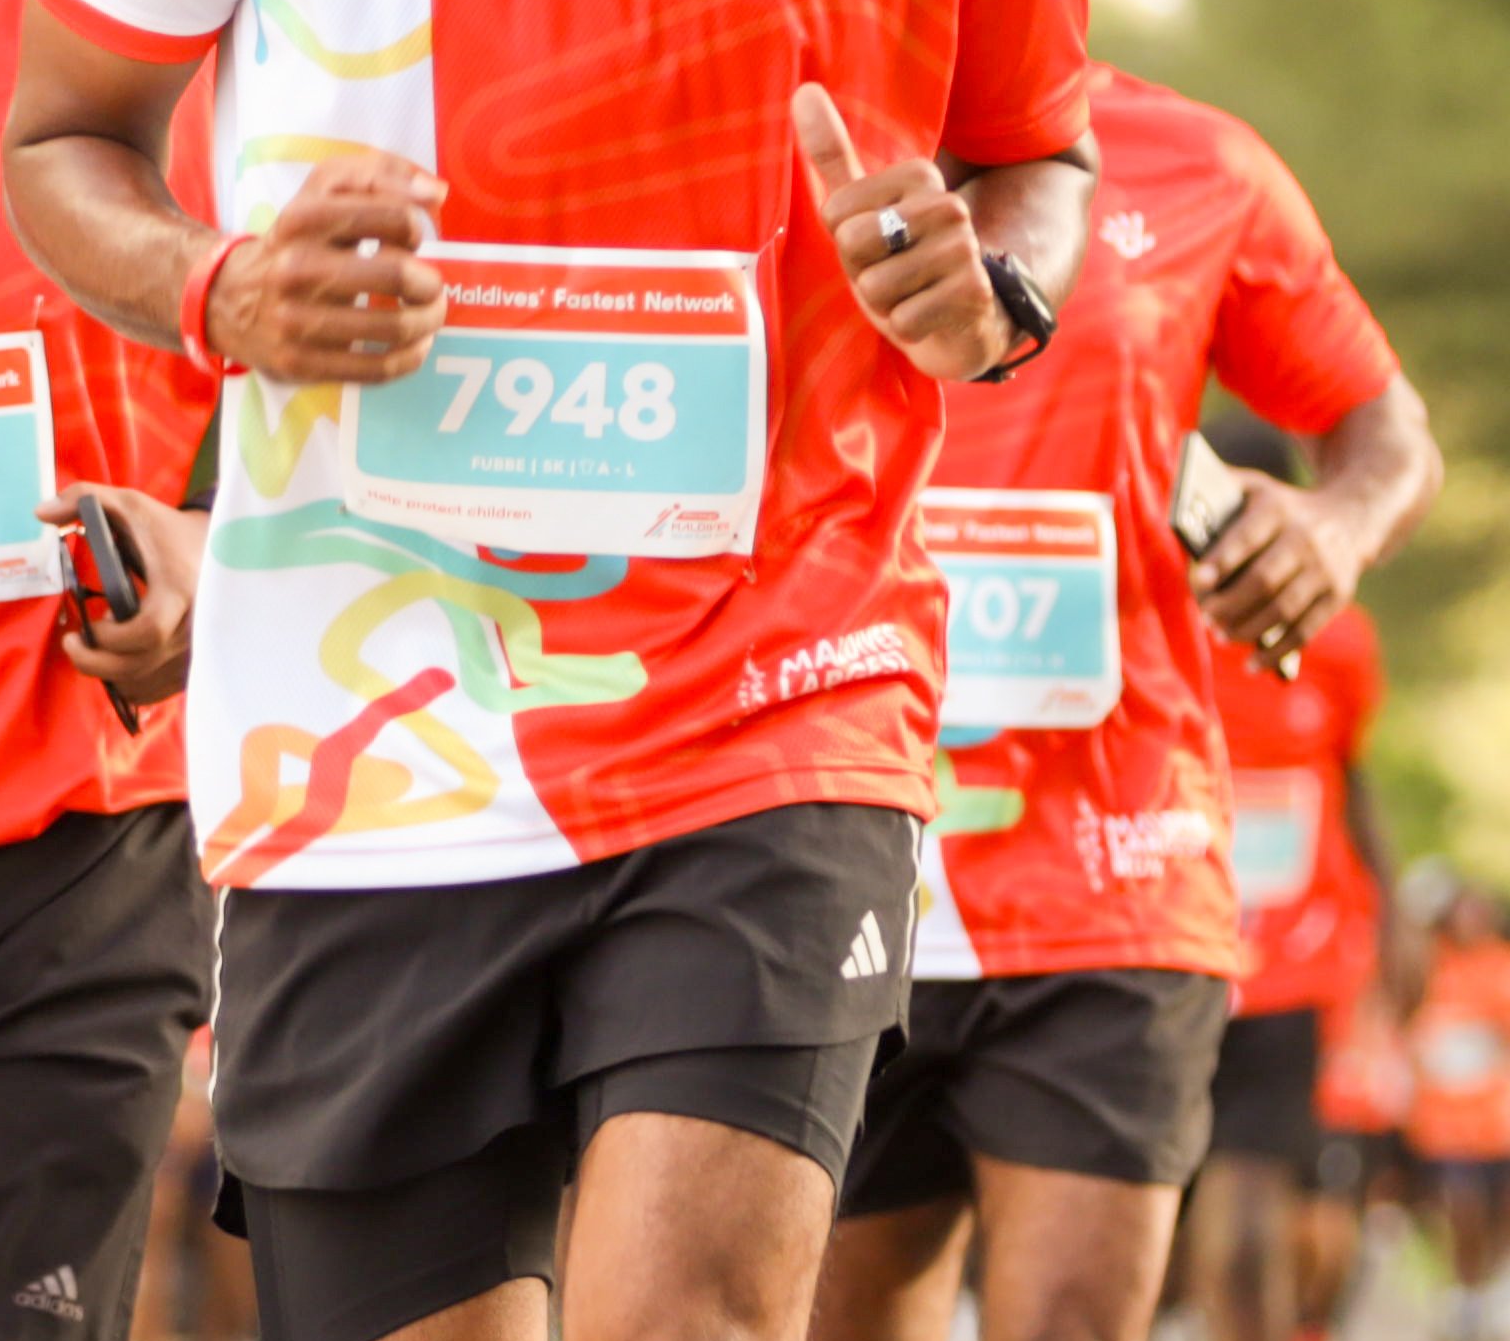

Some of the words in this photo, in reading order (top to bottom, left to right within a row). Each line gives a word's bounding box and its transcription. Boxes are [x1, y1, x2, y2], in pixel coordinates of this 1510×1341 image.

[443, 285, 544, 308] Maldives'
[554, 288, 634, 311] Fastest
[645, 291, 734, 312] Network
[435, 356, 676, 441] 7948
[406, 499, 461, 516] protect
[467, 506, 532, 521] children
[14, 1292, 84, 1322] adidas
